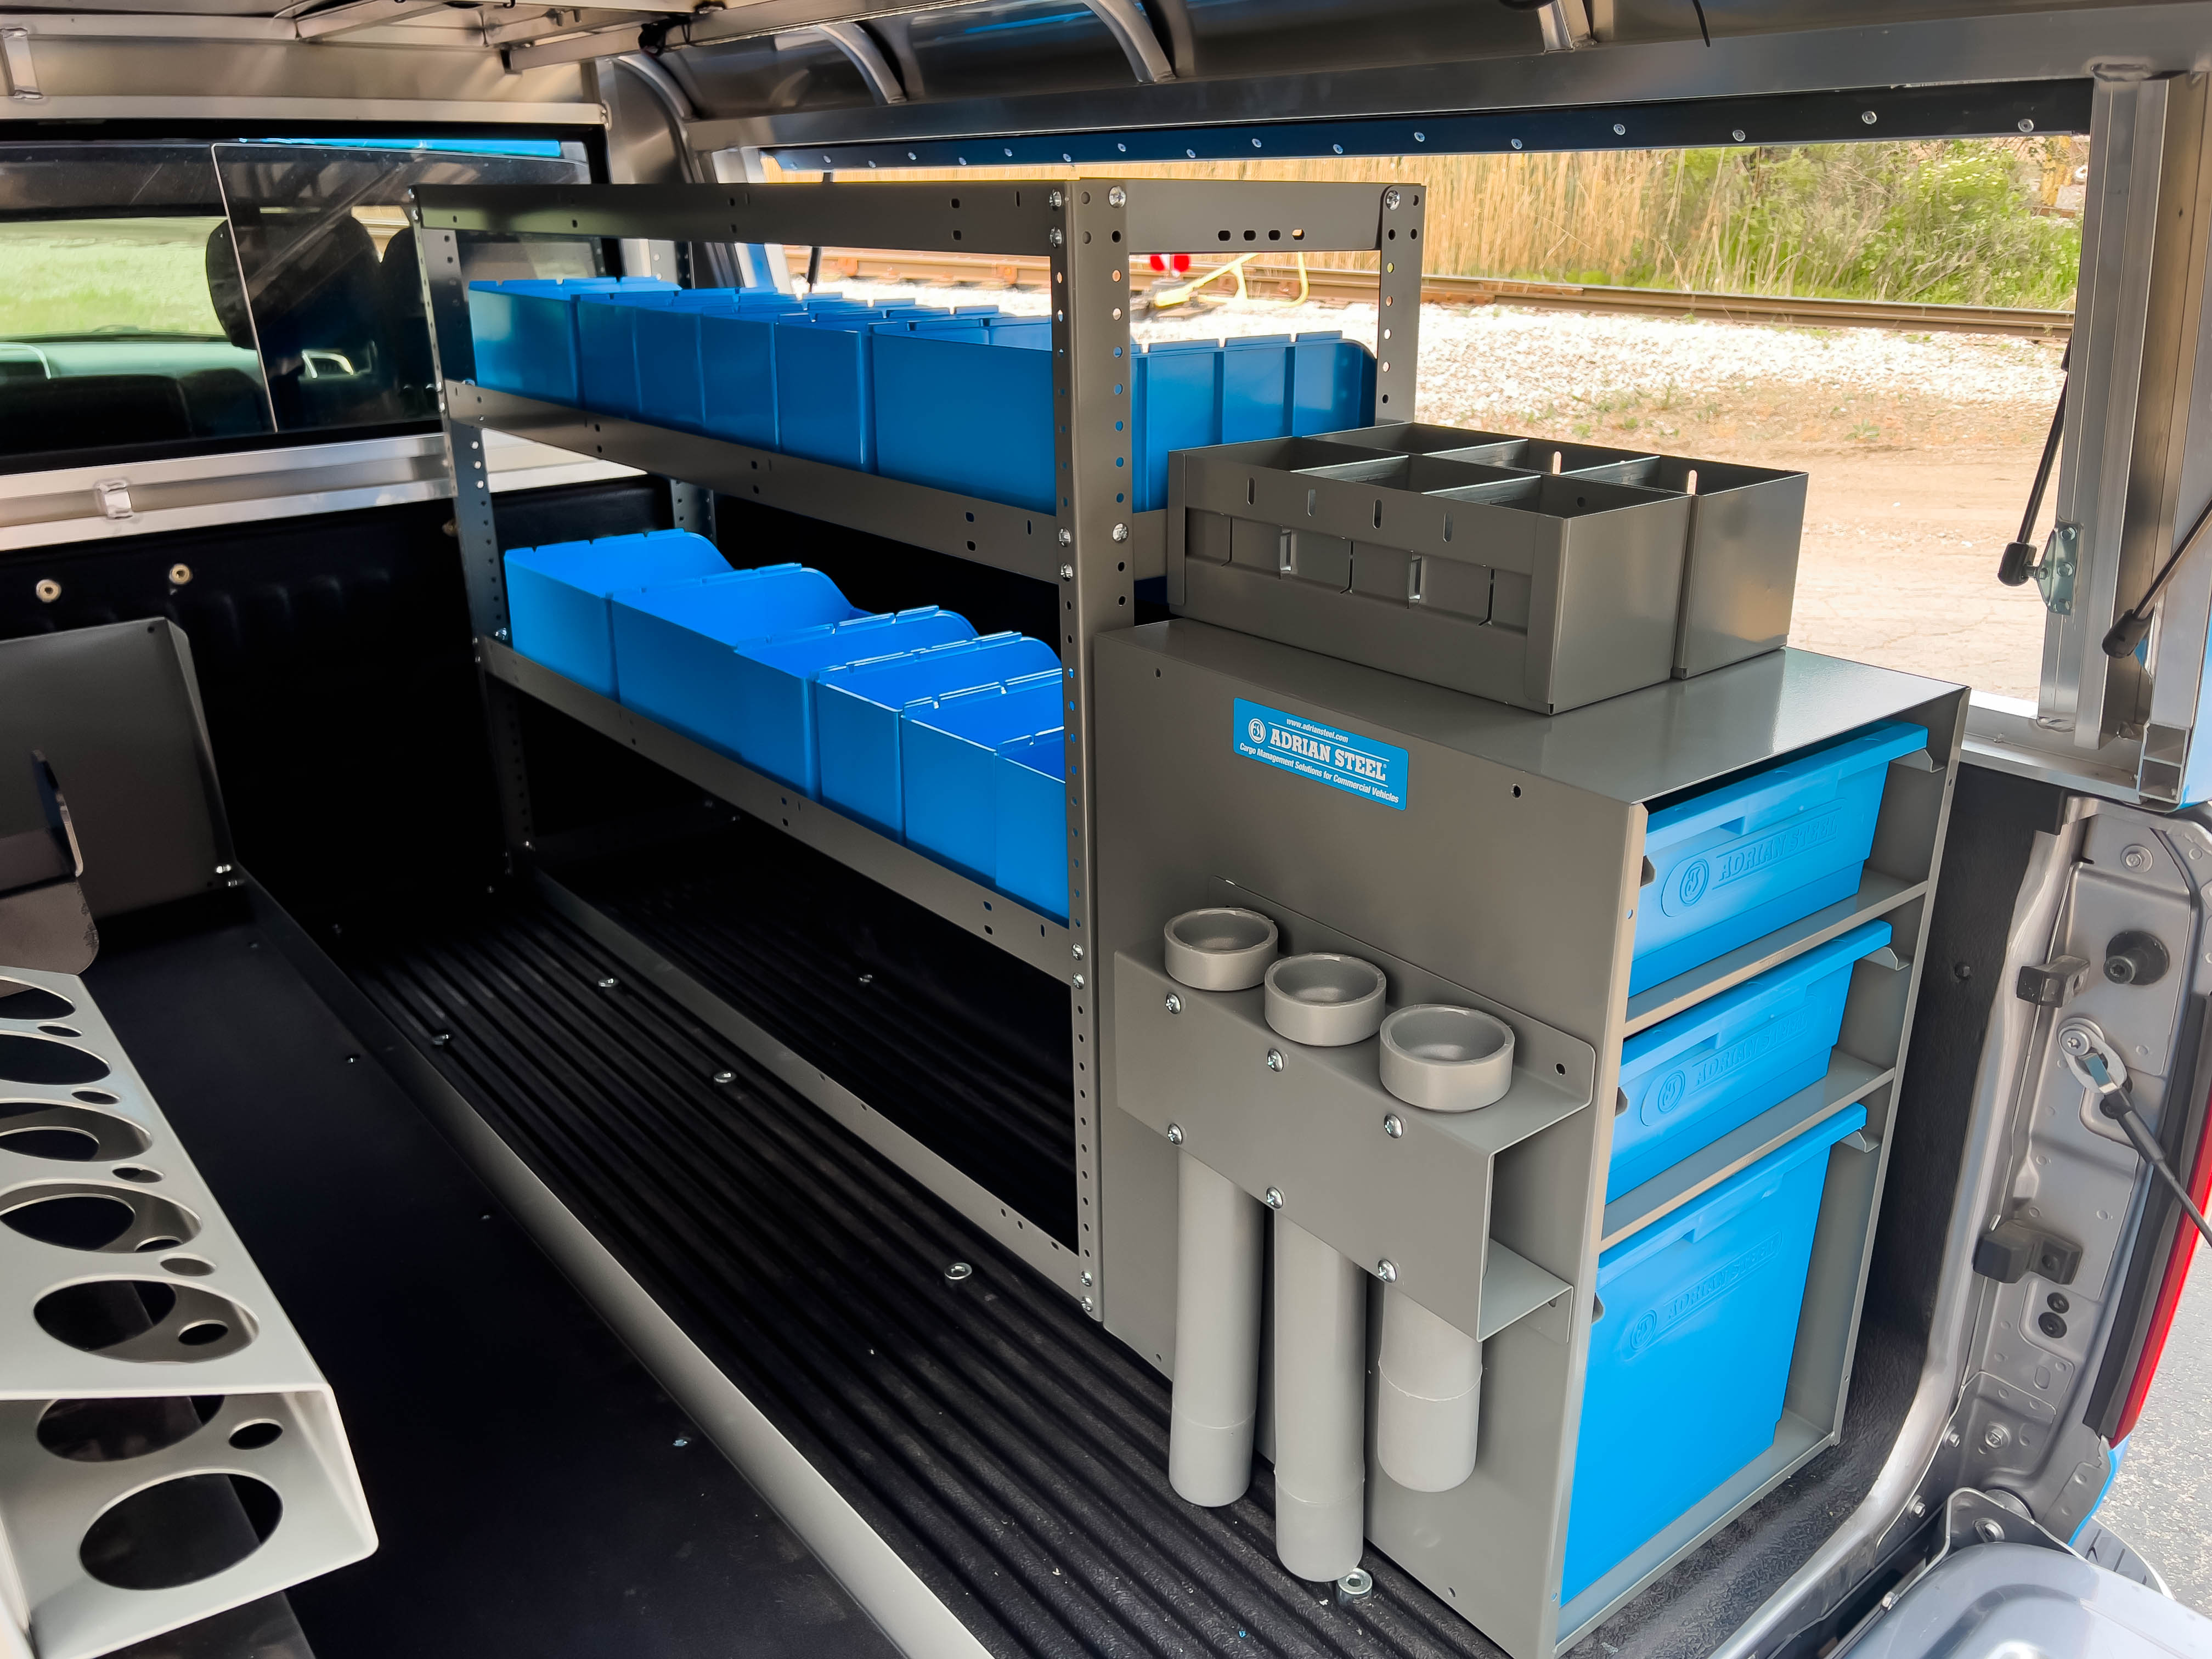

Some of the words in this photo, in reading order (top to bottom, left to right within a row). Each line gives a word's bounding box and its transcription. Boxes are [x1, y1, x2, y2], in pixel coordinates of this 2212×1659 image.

[1270, 728, 1331, 763] ADRIAN
[1334, 749, 1386, 781] STEEL
[1286, 718, 1348, 743] www.adriansteel.com
[1239, 742, 1256, 755] Cargo
[1256, 748, 1294, 768] Management
[1295, 761, 1323, 777] Solutions
[1323, 770, 1333, 781] for
[1333, 774, 1372, 794] Commercial
[1372, 787, 1400, 804] Vehicles
[1718, 834, 1787, 882] ADRIAN
[1789, 814, 1839, 848] STEEL
